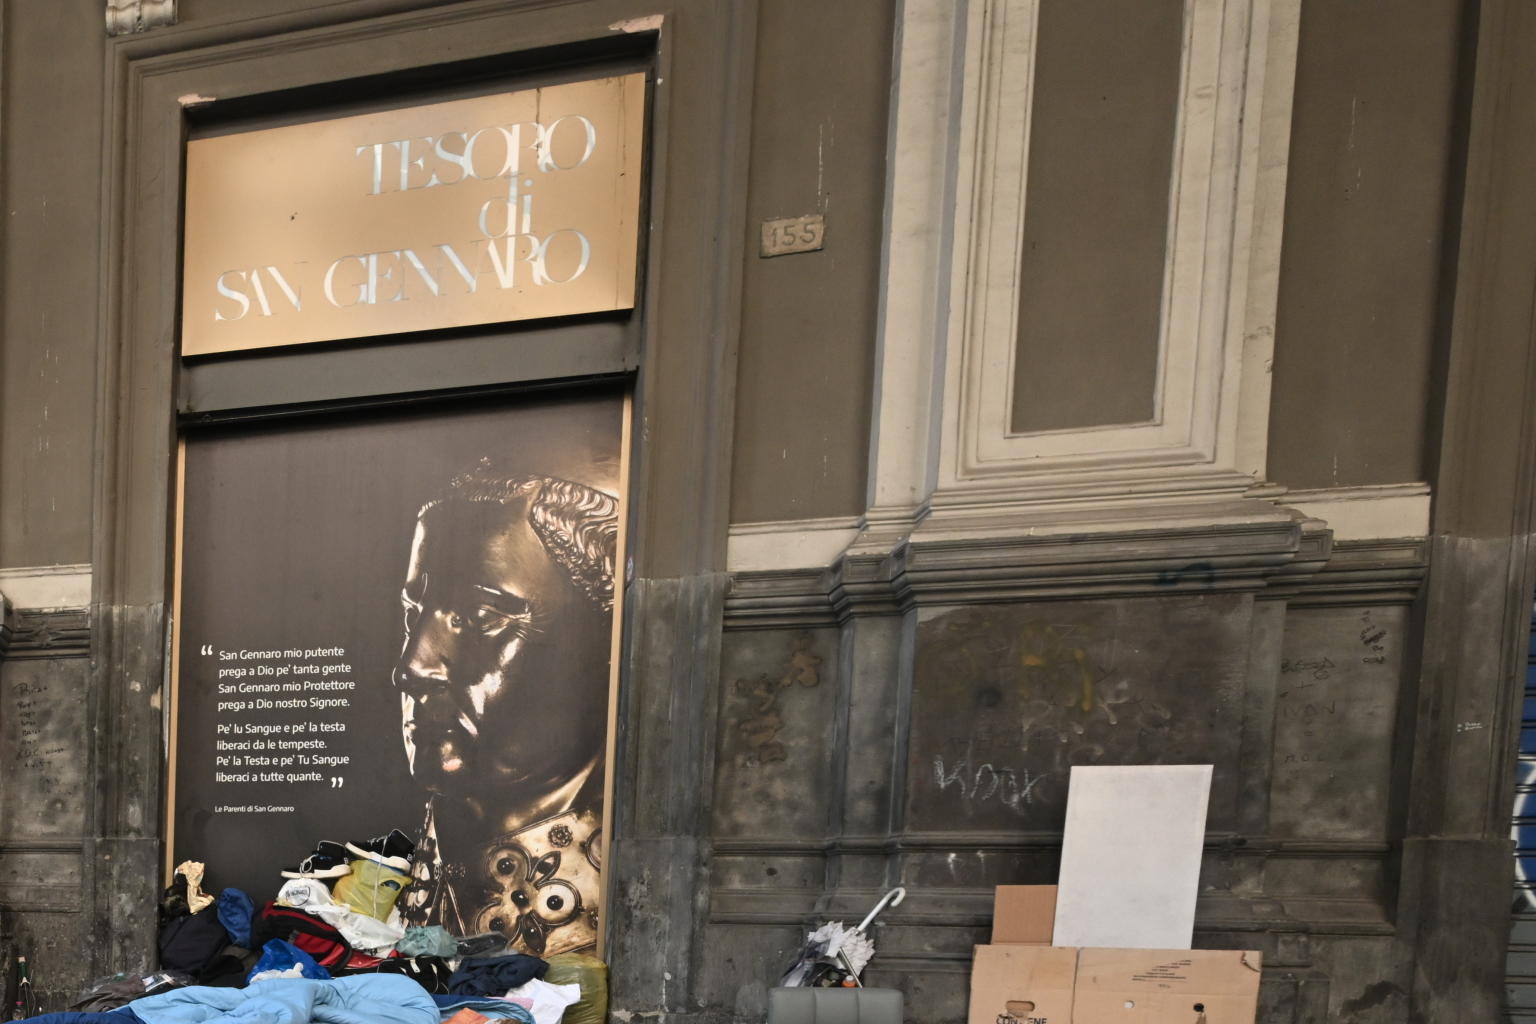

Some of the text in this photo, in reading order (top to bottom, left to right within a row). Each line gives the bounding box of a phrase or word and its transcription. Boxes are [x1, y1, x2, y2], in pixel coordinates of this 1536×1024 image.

[356, 115, 597, 196] TESORO
[479, 174, 534, 239] di
[771, 222, 816, 248] 155
[215, 228, 591, 321] SAN GENNARO
[219, 646, 345, 661] San Gennaro mio putente
[219, 668, 247, 679] prega
[257, 665, 275, 676] Dio
[276, 663, 291, 678] pe'
[292, 664, 320, 675] tanta
[321, 663, 352, 676] gente
[218, 680, 356, 694] San Gennaro mio Protettore
[217, 701, 246, 712] prega
[256, 698, 273, 709] Dio
[275, 697, 308, 709] nostro
[309, 697, 350, 710] Signore.
[217, 723, 232, 734] Pe'
[244, 723, 282, 736] Sangue
[292, 721, 307, 735] pe'
[319, 721, 346, 733] testa
[216, 739, 251, 751] liberaci
[277, 738, 327, 752] tempeste.
[216, 755, 231, 766] Pe'
[243, 755, 270, 766] Testa
[280, 754, 296, 768] pe'
[312, 754, 350, 767] Sangue
[215, 771, 250, 783] liberaci
[259, 771, 285, 782] tutte
[286, 771, 324, 784] quante.
[223, 804, 246, 814] Parenti
[254, 803, 267, 813] San
[267, 802, 295, 813] Gennaro
